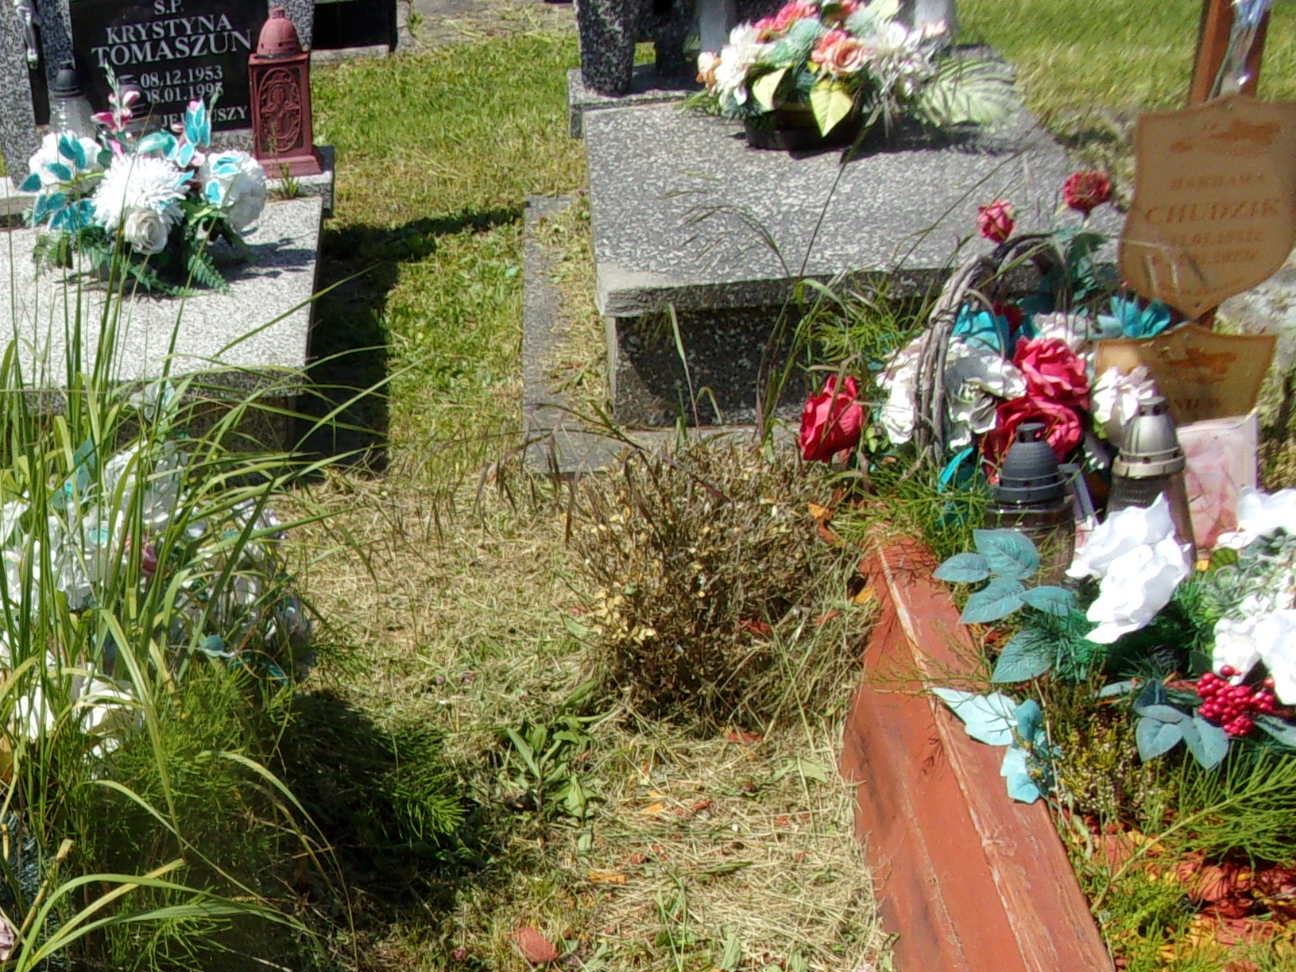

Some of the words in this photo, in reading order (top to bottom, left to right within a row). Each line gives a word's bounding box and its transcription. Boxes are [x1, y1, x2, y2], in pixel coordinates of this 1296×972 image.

[105, 13, 233, 44] KRYSTYNA
[91, 29, 252, 67] TOMASZUN
[140, 65, 224, 88] 08.12.1953
